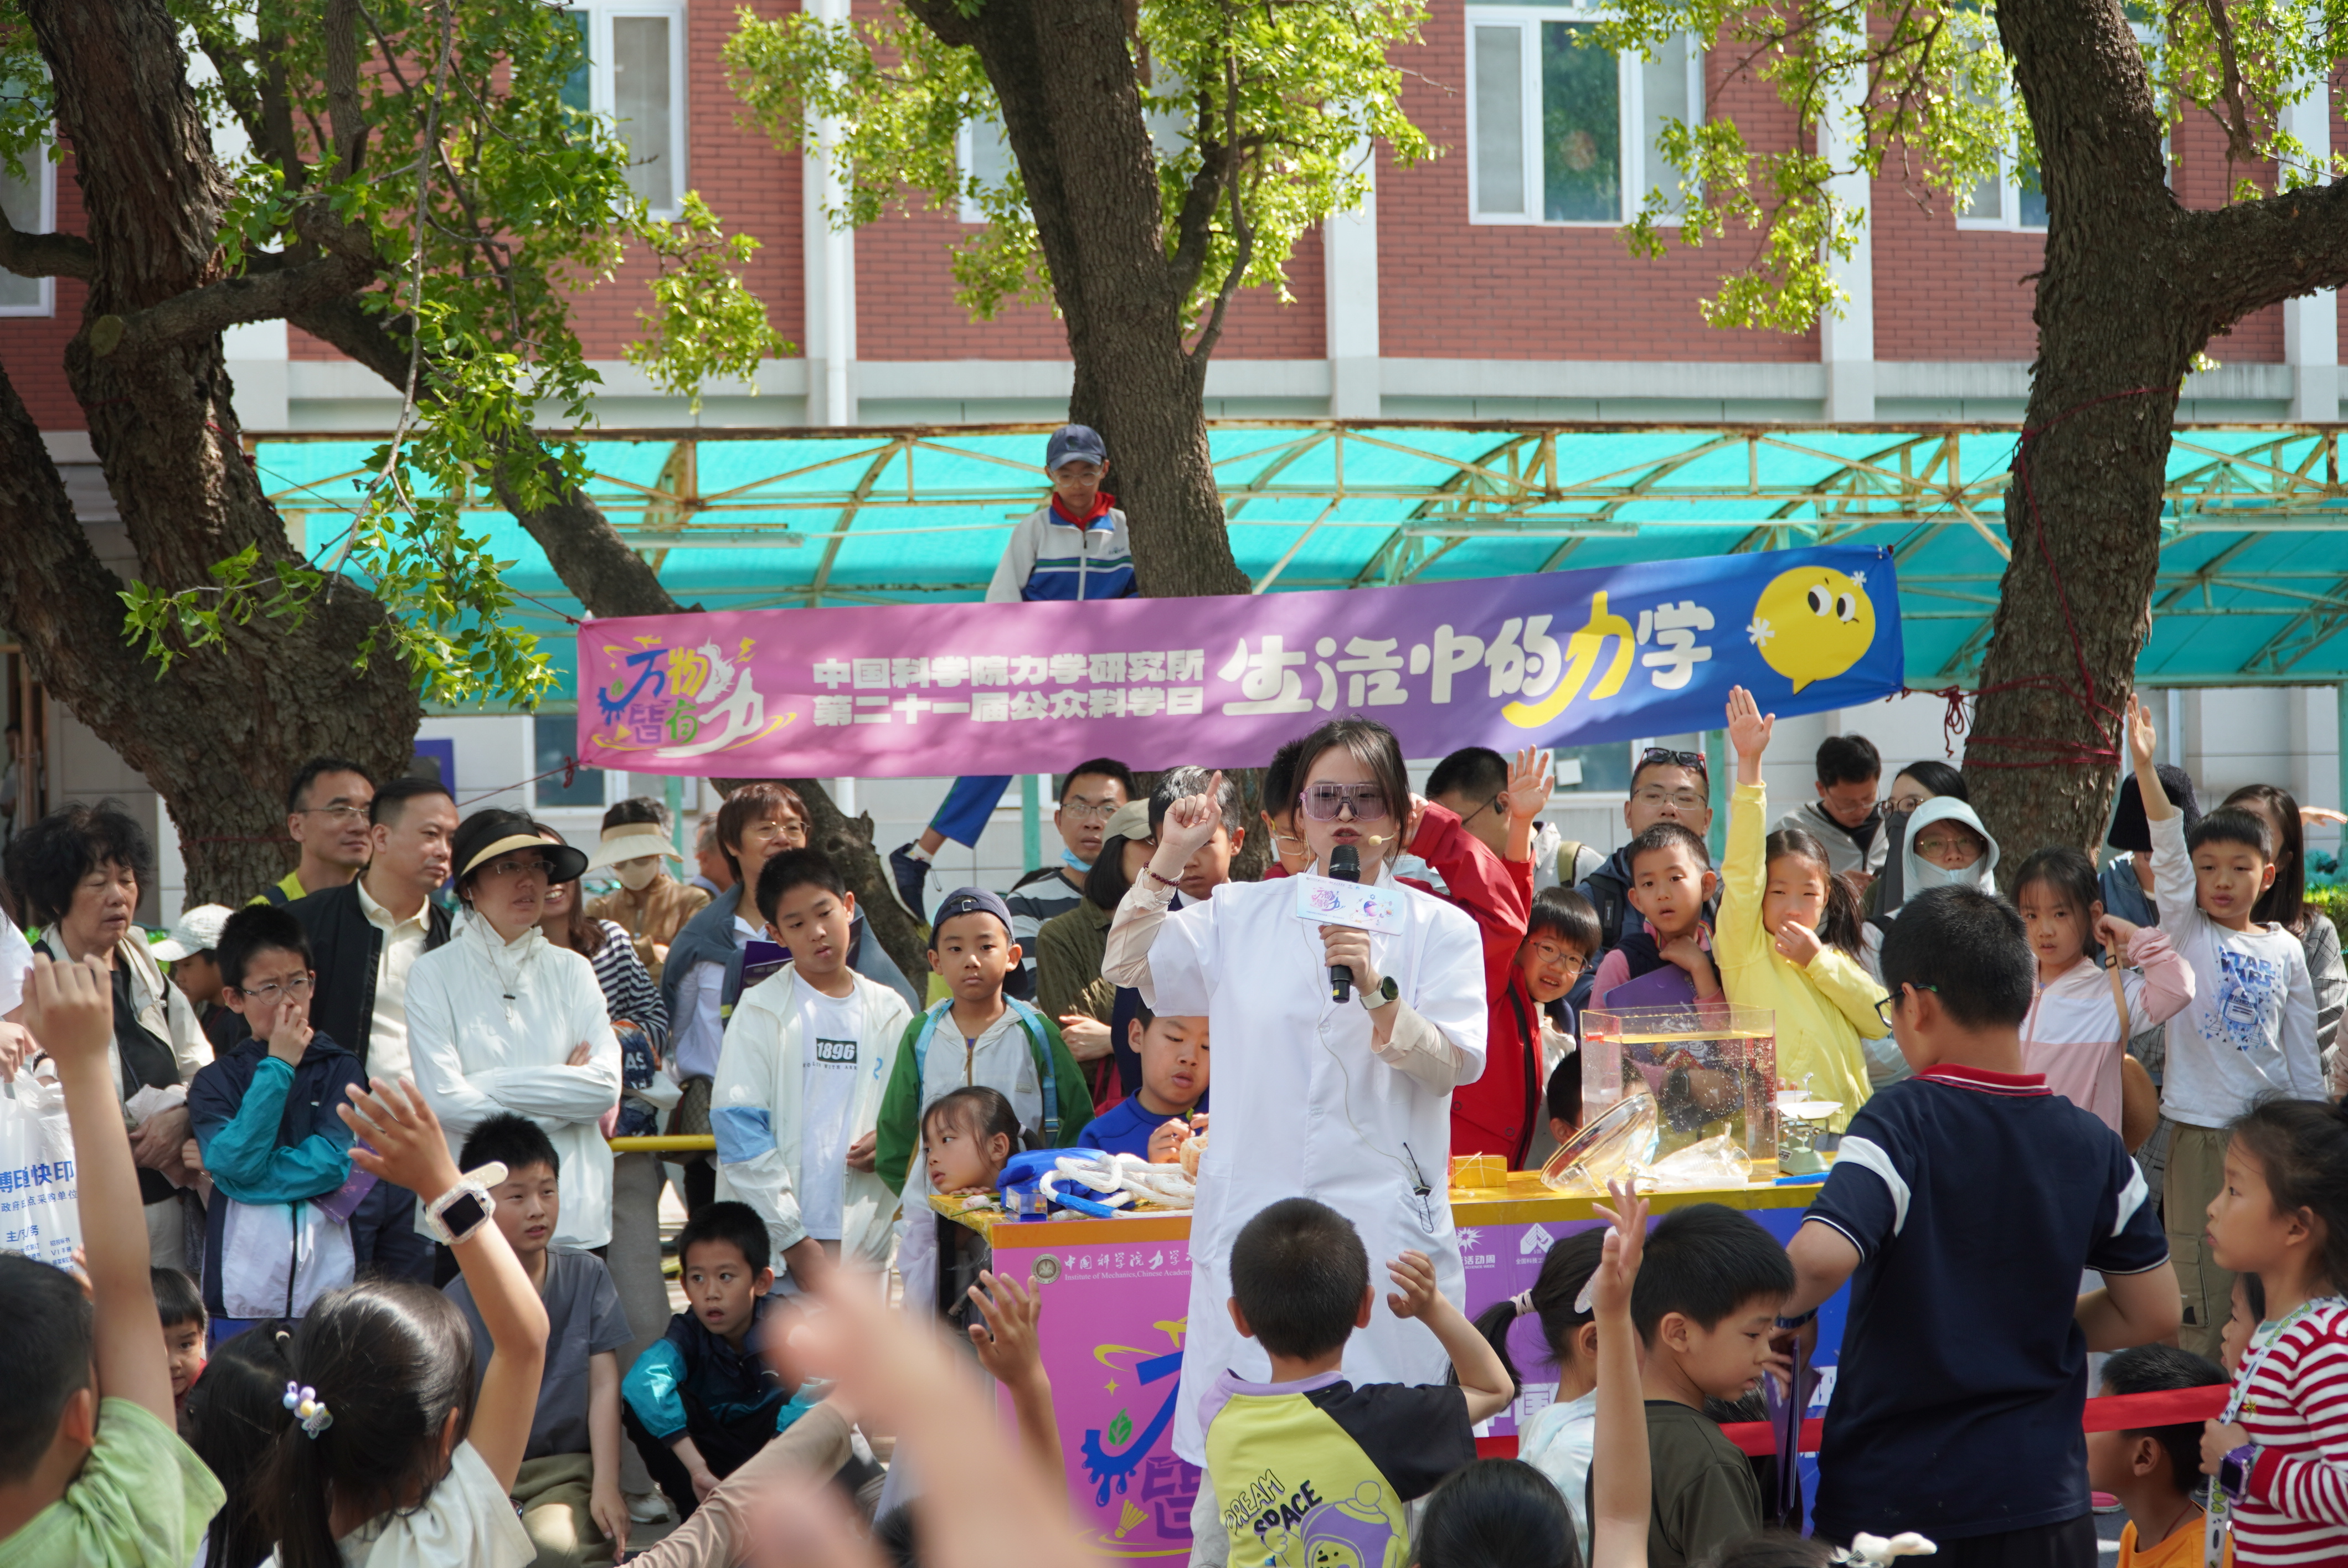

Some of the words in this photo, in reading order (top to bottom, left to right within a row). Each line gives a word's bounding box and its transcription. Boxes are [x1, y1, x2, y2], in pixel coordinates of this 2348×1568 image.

[812, 649, 1205, 690] 中国科学院力学研究所
[1218, 590, 1715, 729] 生活中的力学
[812, 687, 1204, 726] 第二十一届公众科学日
[817, 1041, 856, 1060] 1896
[1165, 1269, 1193, 1277] Academy
[1461, 1255, 1496, 1266] 活动周
[1224, 1468, 1285, 1537] DREAM
